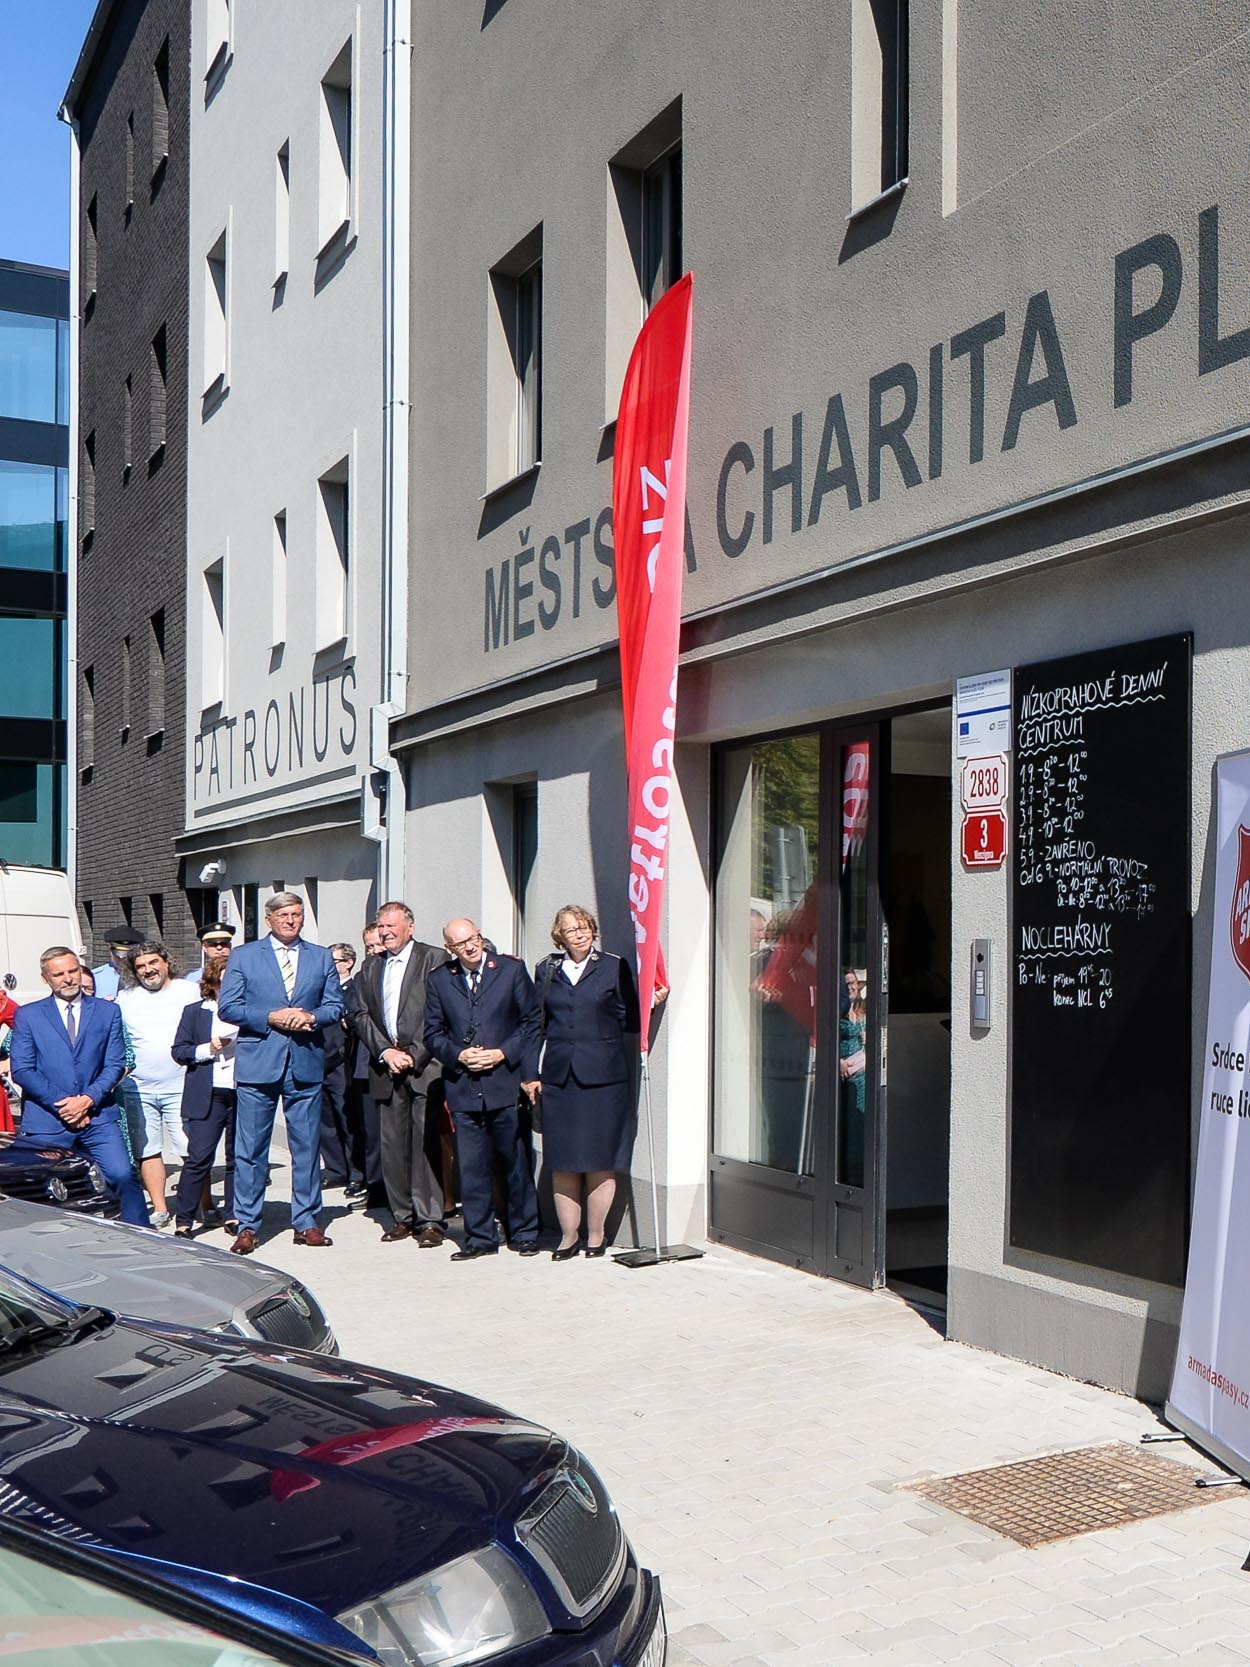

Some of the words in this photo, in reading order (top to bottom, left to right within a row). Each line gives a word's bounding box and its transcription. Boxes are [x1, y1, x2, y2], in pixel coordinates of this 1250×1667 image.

[484, 506, 697, 653] MĚSTS
[716, 289, 1077, 559] CHARITA
[1020, 670, 1116, 720] NÍZKOPRAHOVÉ
[1120, 661, 1168, 697] DENNÍ
[194, 665, 357, 800] PATRONUS
[1019, 716, 1083, 748] CENTRUM
[970, 767, 999, 798] 2838
[980, 818, 989, 849] 3
[1107, 857, 1148, 879] PROVOZ
[1022, 913, 1112, 951] NOCLEHÁRNY
[1211, 1042, 1244, 1072] Srdce
[1210, 1091, 1234, 1115] ruce
[1188, 1355, 1250, 1409] armadaspasy.cz
